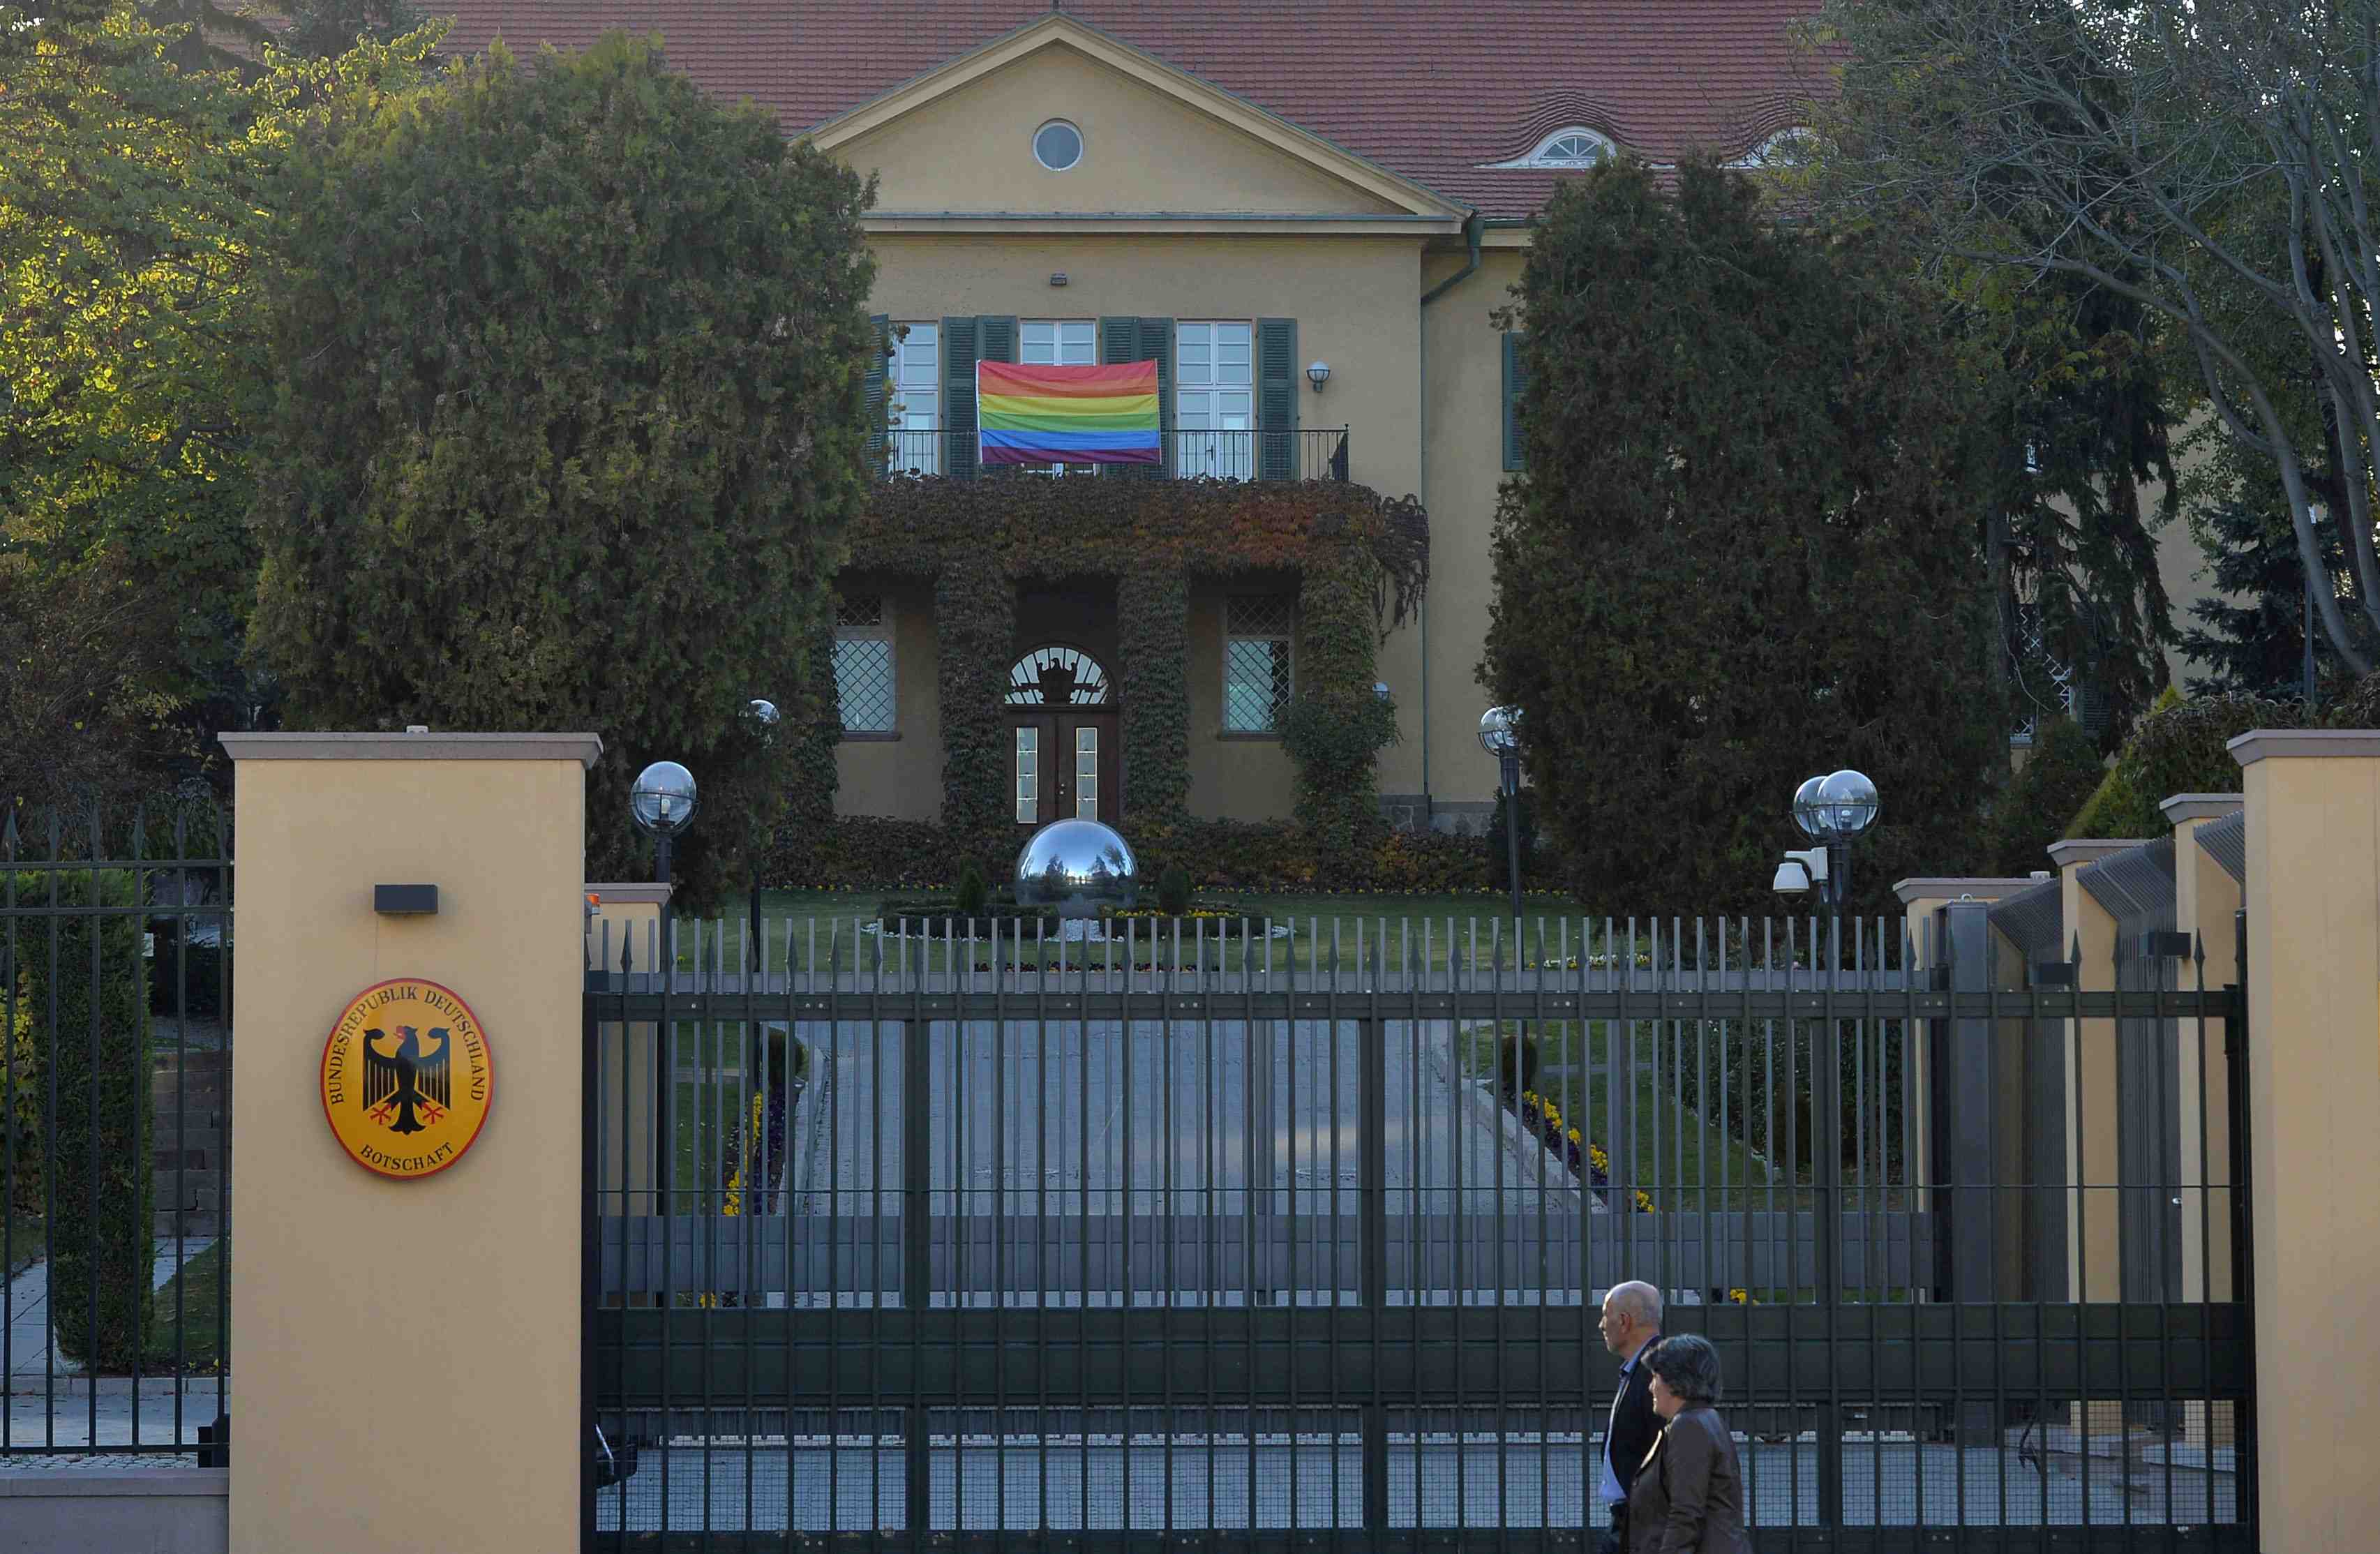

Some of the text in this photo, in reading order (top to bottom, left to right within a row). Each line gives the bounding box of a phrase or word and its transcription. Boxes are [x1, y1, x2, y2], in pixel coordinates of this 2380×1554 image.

[329, 986, 486, 1105] BUNDESREPUBLIK DEUTSCHLAND
[360, 1142, 454, 1170] BOTSCHAFT
